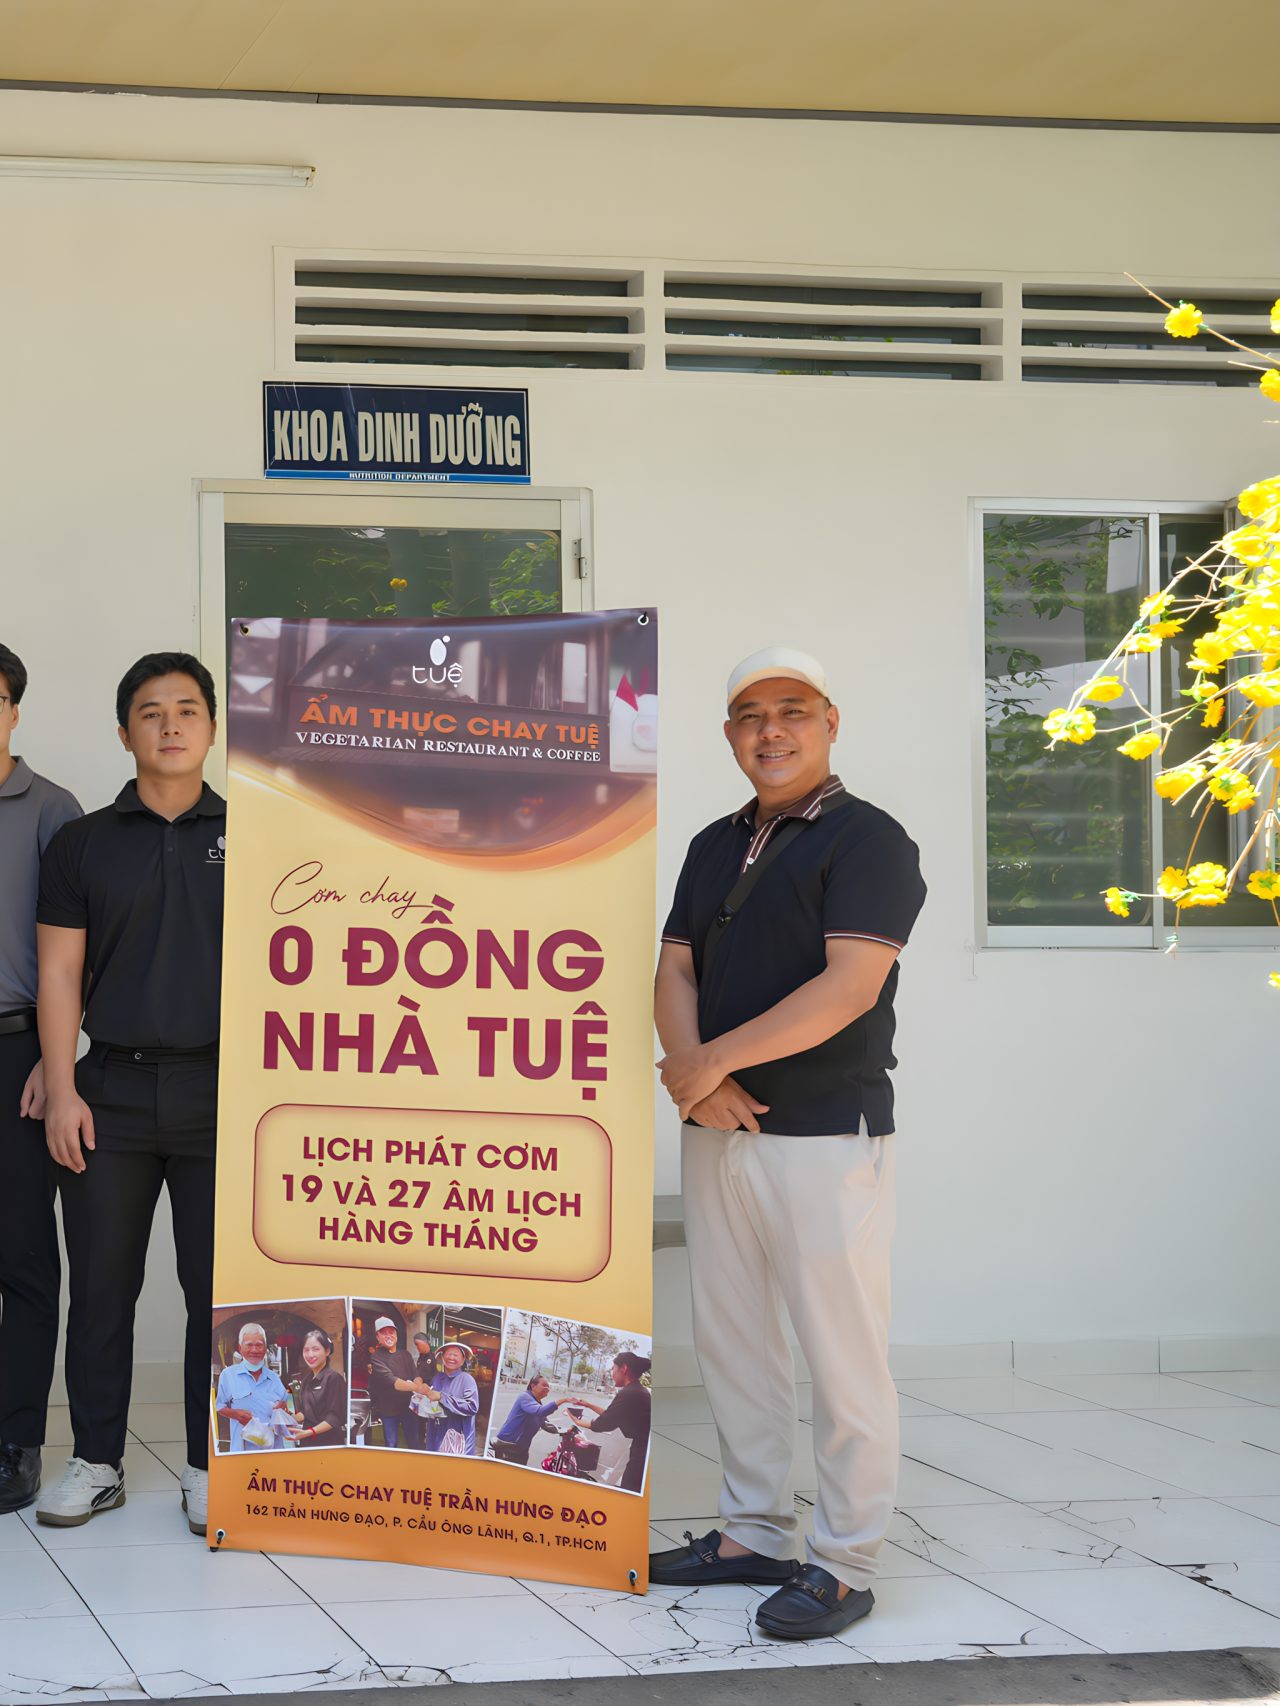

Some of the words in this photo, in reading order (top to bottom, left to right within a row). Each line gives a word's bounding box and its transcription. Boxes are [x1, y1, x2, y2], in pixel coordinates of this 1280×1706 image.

[273, 409, 348, 462] KHOA
[357, 411, 421, 463] DINH
[429, 402, 522, 467] DƯỠNG
[412, 662, 463, 688] tuệ
[299, 693, 358, 727] ẨM
[369, 707, 458, 737] THỰC
[467, 716, 548, 741] CHAY
[555, 722, 599, 749] TUỆ
[296, 731, 416, 750] VEGETARIAN
[423, 739, 529, 758] RESTAURANT
[532, 747, 543, 759] &
[547, 748, 601, 762] COFFEE
[208, 848, 225, 859] tu
[270, 860, 347, 915] Cơm
[360, 875, 434, 919] chay
[342, 894, 605, 993] ĐỒNG
[263, 994, 439, 1076] NHÀ
[467, 1000, 608, 1101] TUỆ
[303, 1135, 373, 1167] LỊCH
[385, 1135, 467, 1167] PHÁT
[477, 1142, 558, 1171] CƠM
[282, 1173, 323, 1203] 19
[333, 1174, 377, 1207] VÀ
[388, 1179, 431, 1209] 27
[443, 1179, 494, 1213] ÂM
[507, 1190, 581, 1222] LỊCH
[319, 1211, 413, 1244] HÀNG
[424, 1218, 539, 1253] THÁNG
[247, 1468, 277, 1492] ẨM
[283, 1479, 334, 1500] THỰC
[340, 1484, 395, 1503] CHAY
[401, 1487, 432, 1510] TUỆ
[438, 1489, 489, 1513] TRẦN
[495, 1499, 554, 1520] HƯNG
[561, 1507, 608, 1528] ĐẠO
[246, 1504, 269, 1516] 162
[311, 1508, 350, 1523] HƯNG
[354, 1513, 388, 1528] ĐẠO,
[393, 1516, 402, 1528] P.
[441, 1519, 473, 1535] ÔNG
[555, 1535, 607, 1552] TP.HCM
